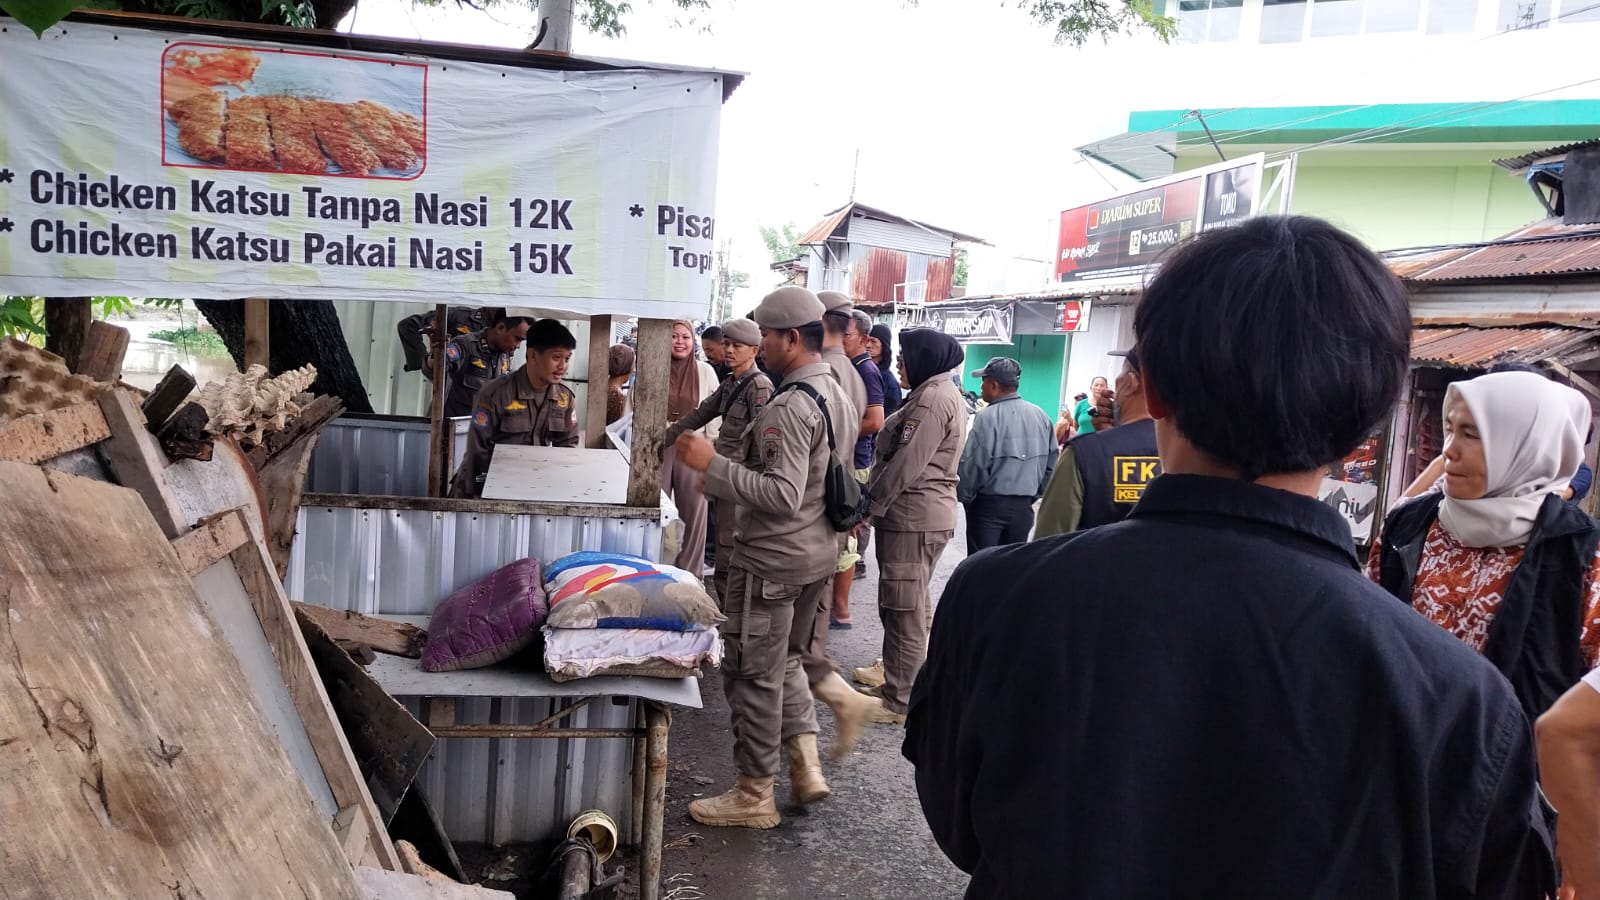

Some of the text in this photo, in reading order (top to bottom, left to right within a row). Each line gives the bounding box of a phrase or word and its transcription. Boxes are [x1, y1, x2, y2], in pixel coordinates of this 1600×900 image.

[30, 169, 575, 231] Chicken Katsu Tanpa Nasi 12K
[1132, 196, 1161, 217] SUPER
[657, 204, 715, 241] Pisa
[30, 218, 574, 275] Chicken Katsu Pakai Nasi 15K
[668, 245, 713, 275] Topi
[1121, 462, 1158, 482] FK
[1118, 489, 1141, 500] KEL
